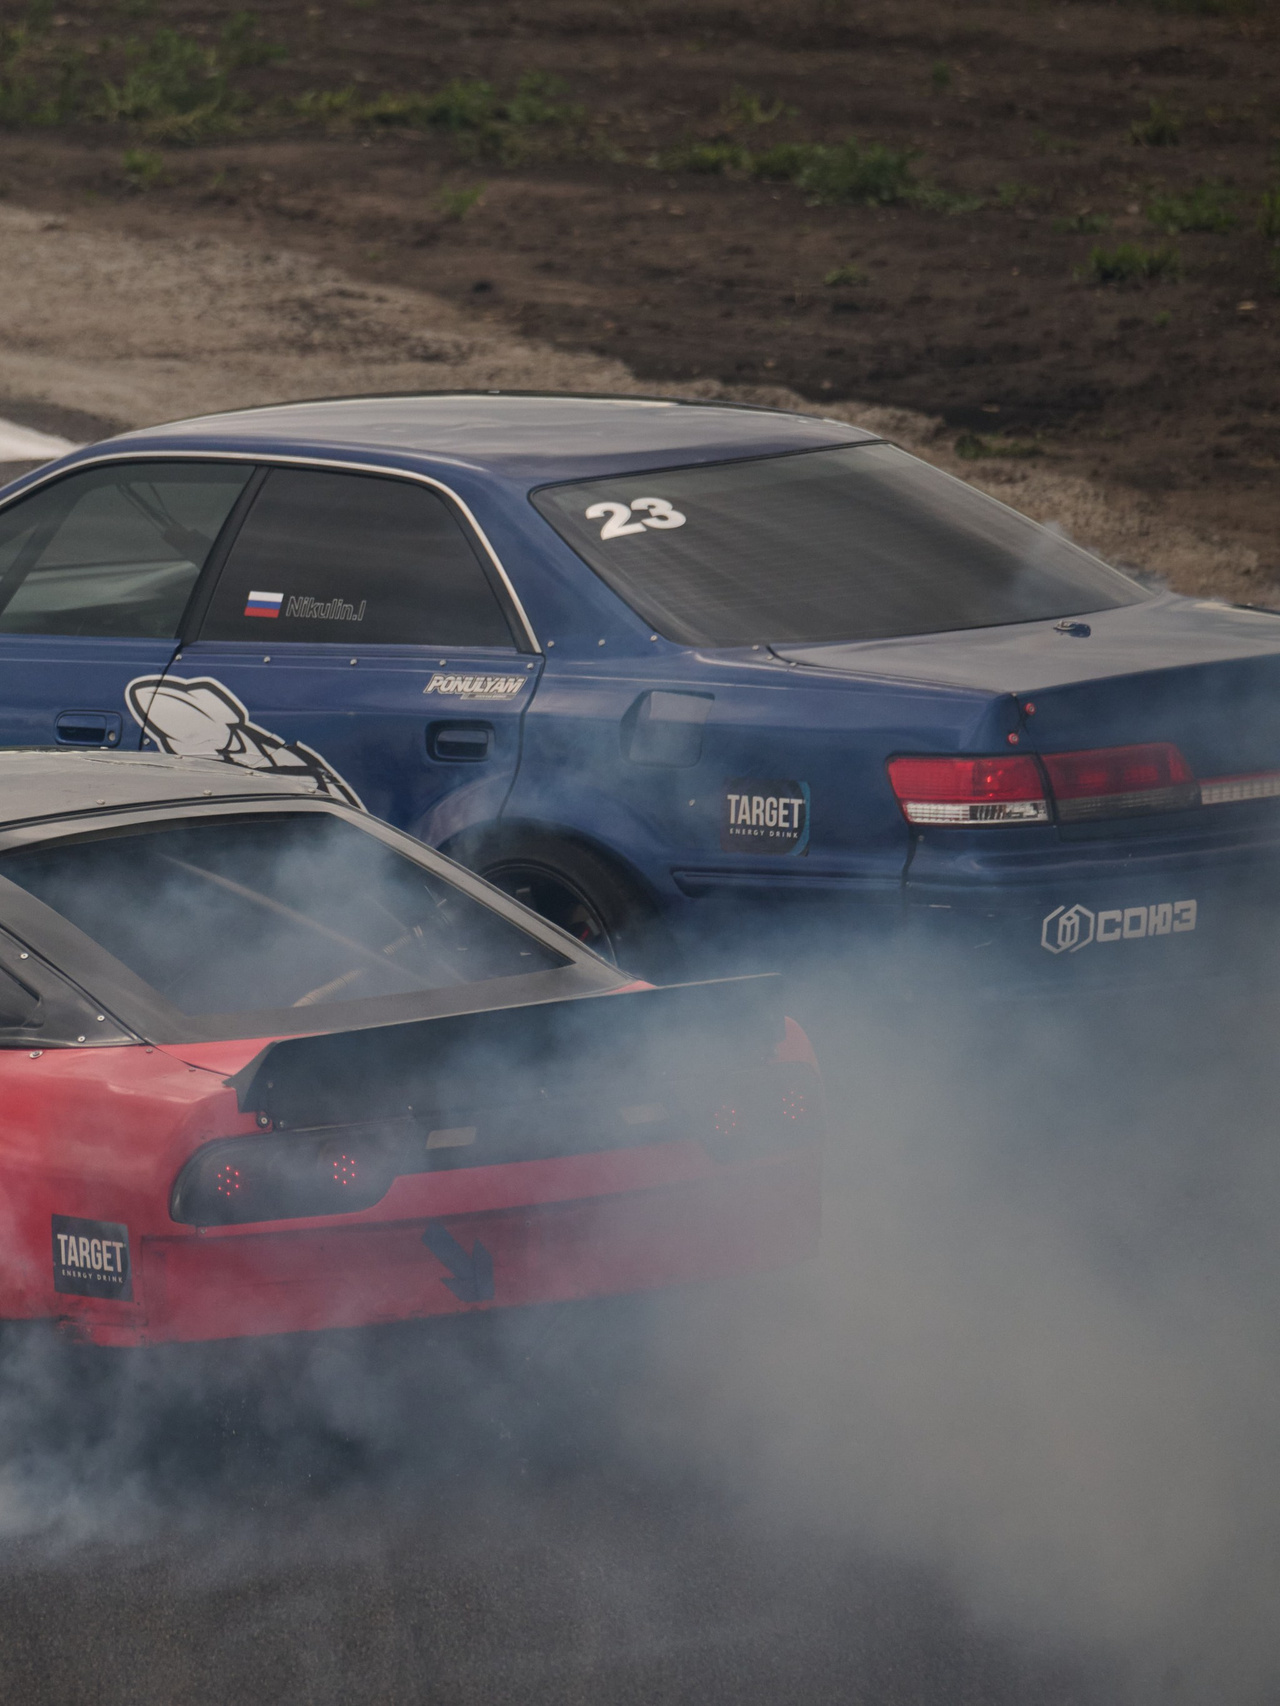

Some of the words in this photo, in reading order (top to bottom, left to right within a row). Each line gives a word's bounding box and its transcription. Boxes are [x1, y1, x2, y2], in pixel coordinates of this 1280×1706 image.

[585, 497, 687, 540] 23
[425, 675, 525, 694] PONULYAM
[727, 794, 803, 828] TARGET
[729, 828, 765, 836] ENERGY
[769, 830, 798, 839] DRINK
[1096, 899, 1197, 942] СОЮЗ
[57, 1233, 124, 1273] TARGET
[62, 1269, 92, 1279] ENERGY
[97, 1274, 123, 1284] DRINK
